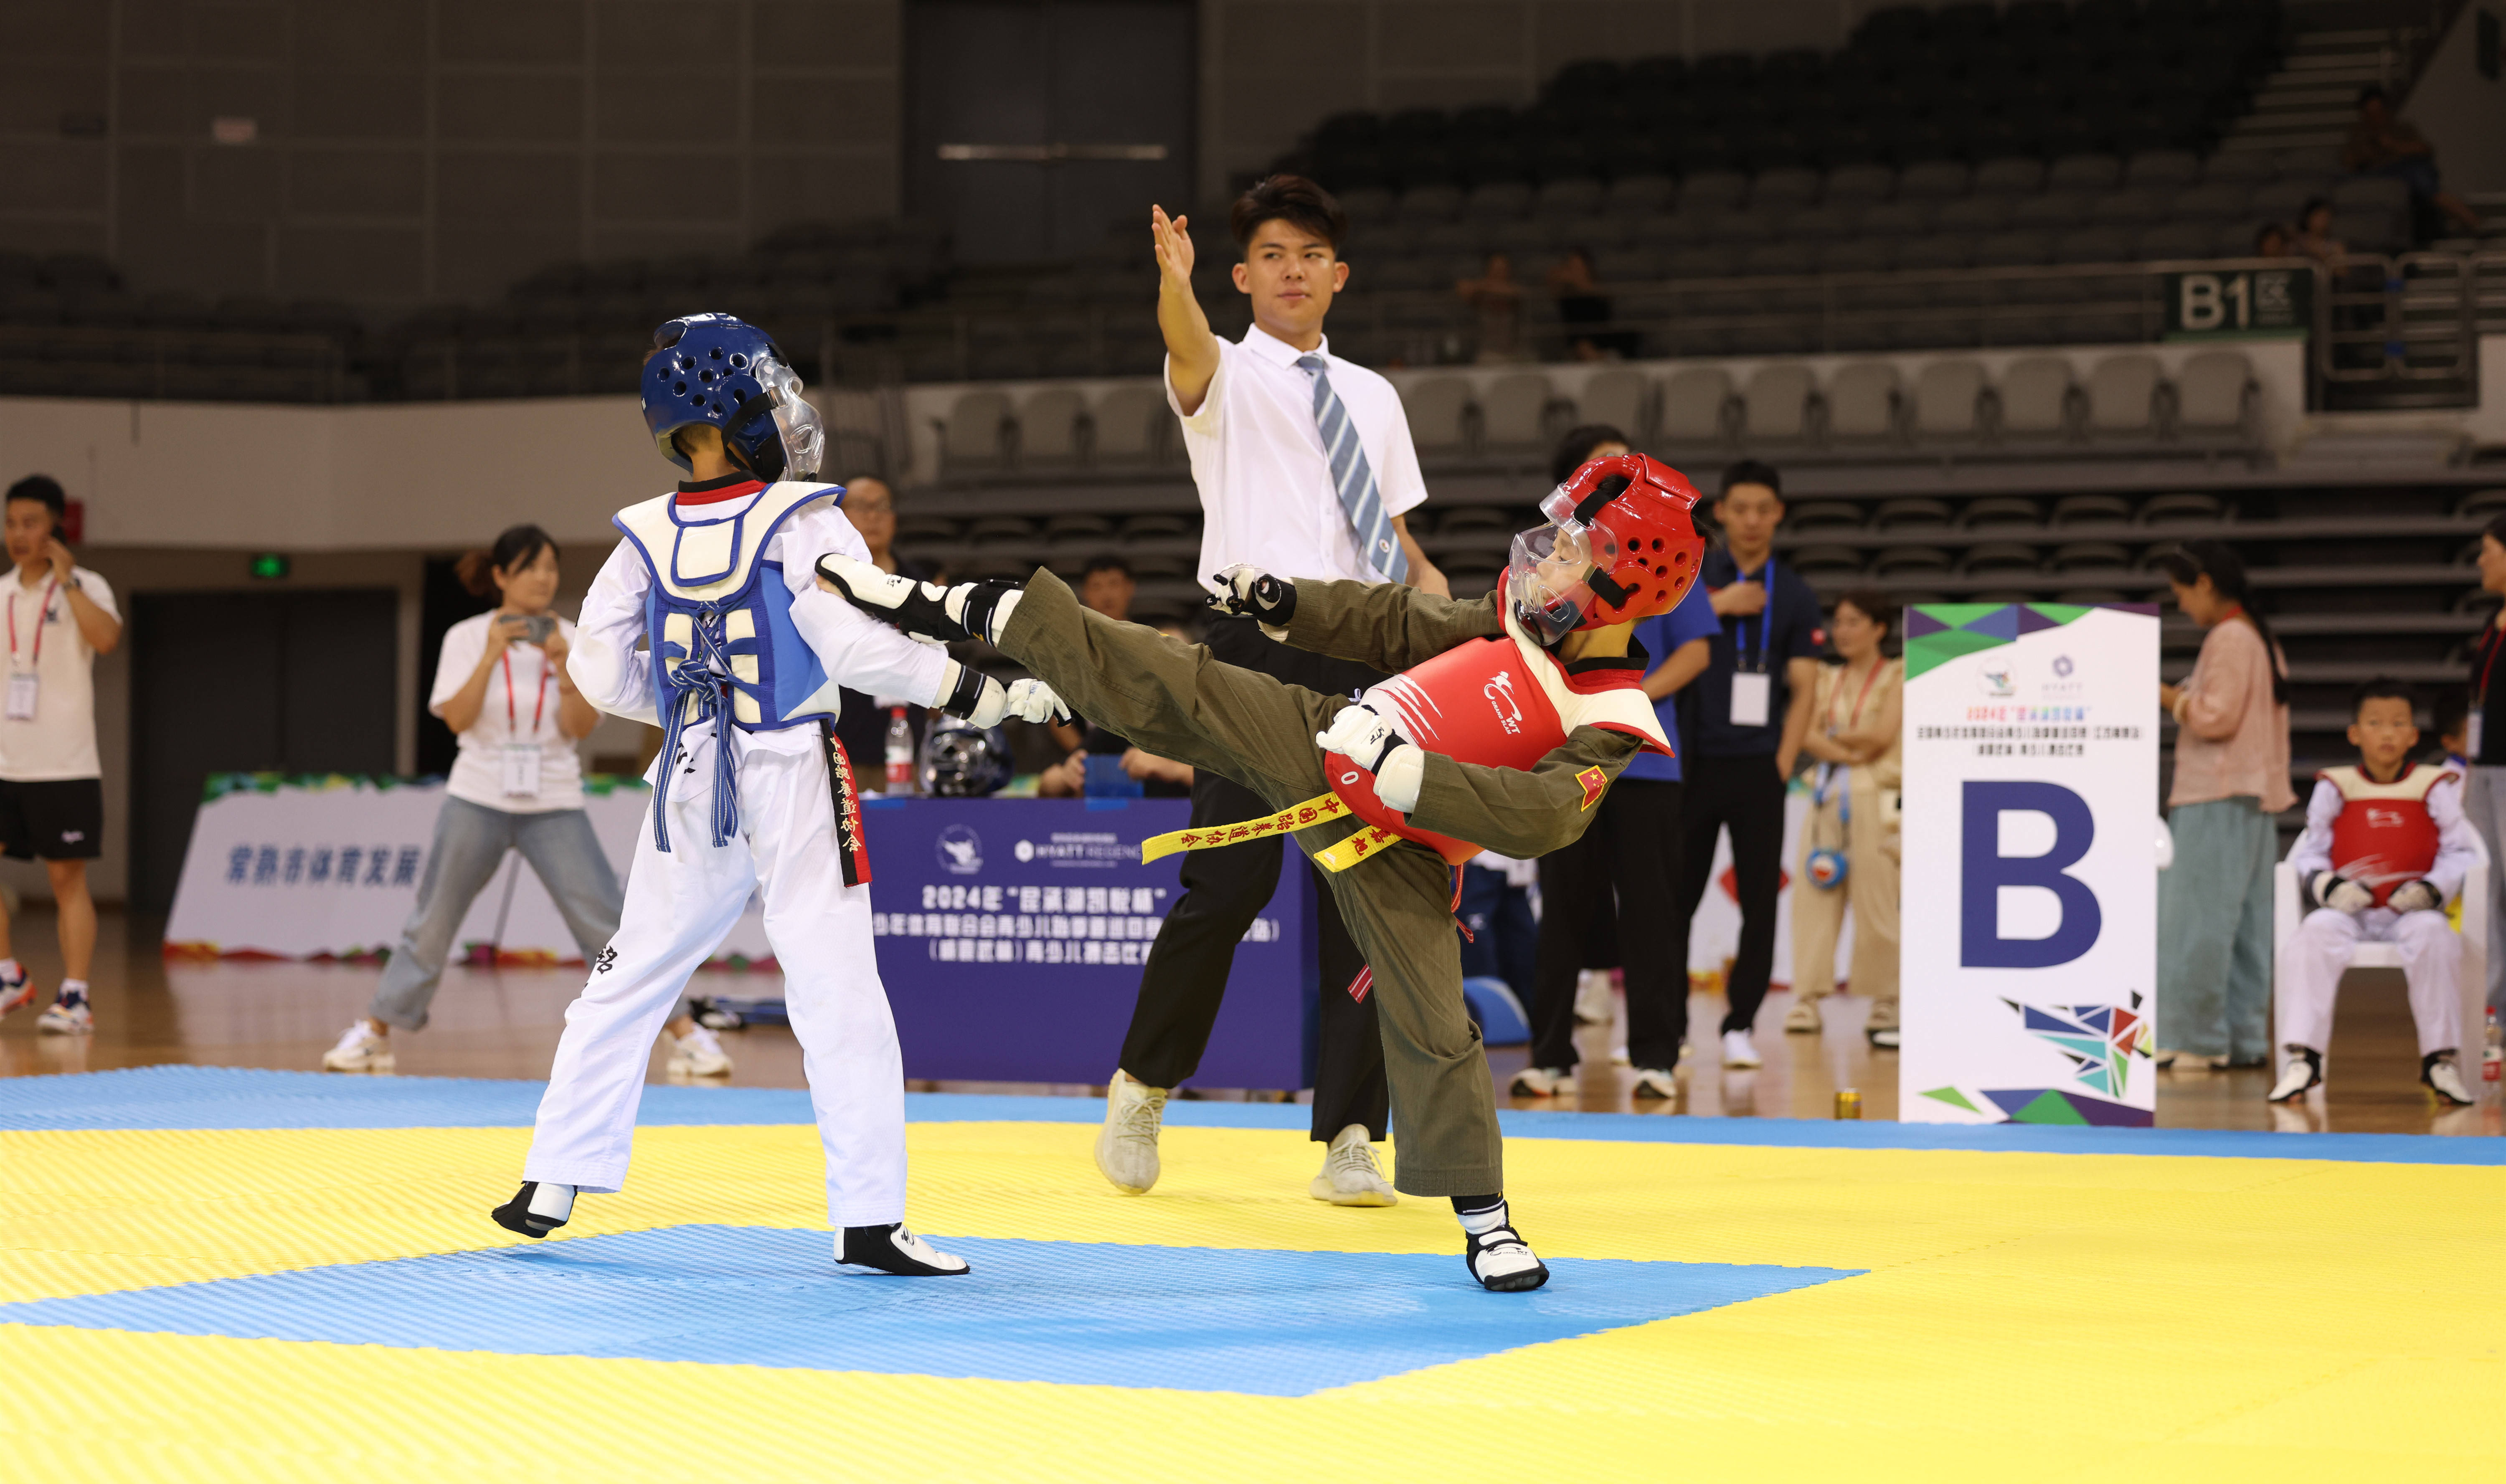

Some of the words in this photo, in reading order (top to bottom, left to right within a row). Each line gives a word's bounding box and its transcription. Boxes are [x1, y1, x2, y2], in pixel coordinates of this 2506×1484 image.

[2180, 274, 2250, 330] B1
[1491, 701, 1504, 719] GRAND
[1501, 720, 1512, 735] SLAM
[1506, 717, 1521, 734] WT
[1180, 797, 1341, 848] 中国跆拳道协会
[228, 845, 421, 885] 常熟市体育发展
[1036, 844, 1085, 859] HYATT
[1086, 844, 1143, 860] REGENC
[1959, 780, 2103, 969] B
